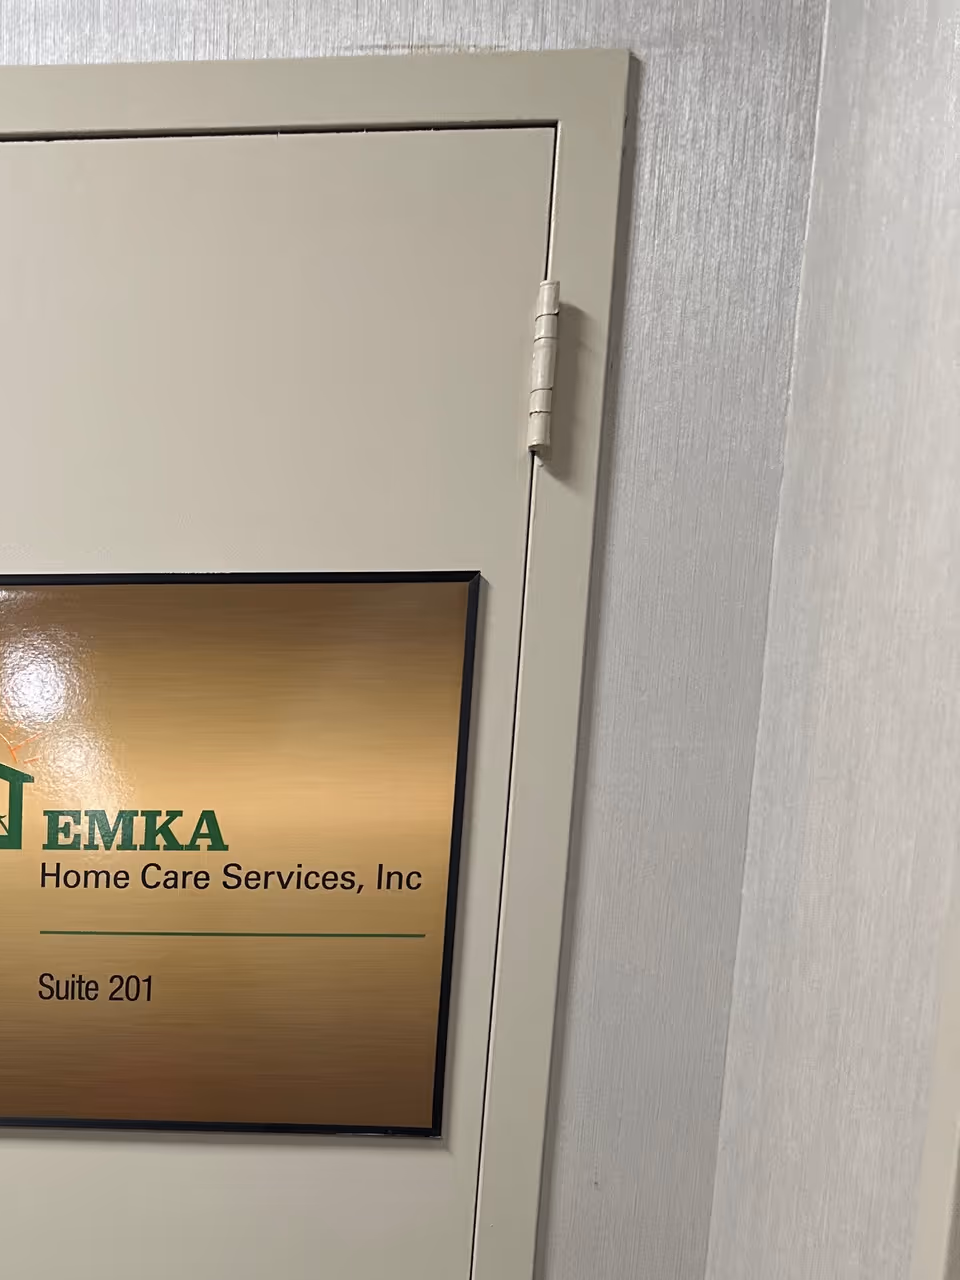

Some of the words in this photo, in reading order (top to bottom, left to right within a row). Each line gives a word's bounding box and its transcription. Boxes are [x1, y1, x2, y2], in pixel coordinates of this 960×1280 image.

[42, 809, 229, 852] EMKA
[40, 862, 130, 890] Home
[140, 864, 210, 891] Care
[222, 864, 365, 894] Services,
[376, 864, 422, 891] Inc
[38, 973, 100, 1001] Suite
[108, 974, 153, 1001] 201
